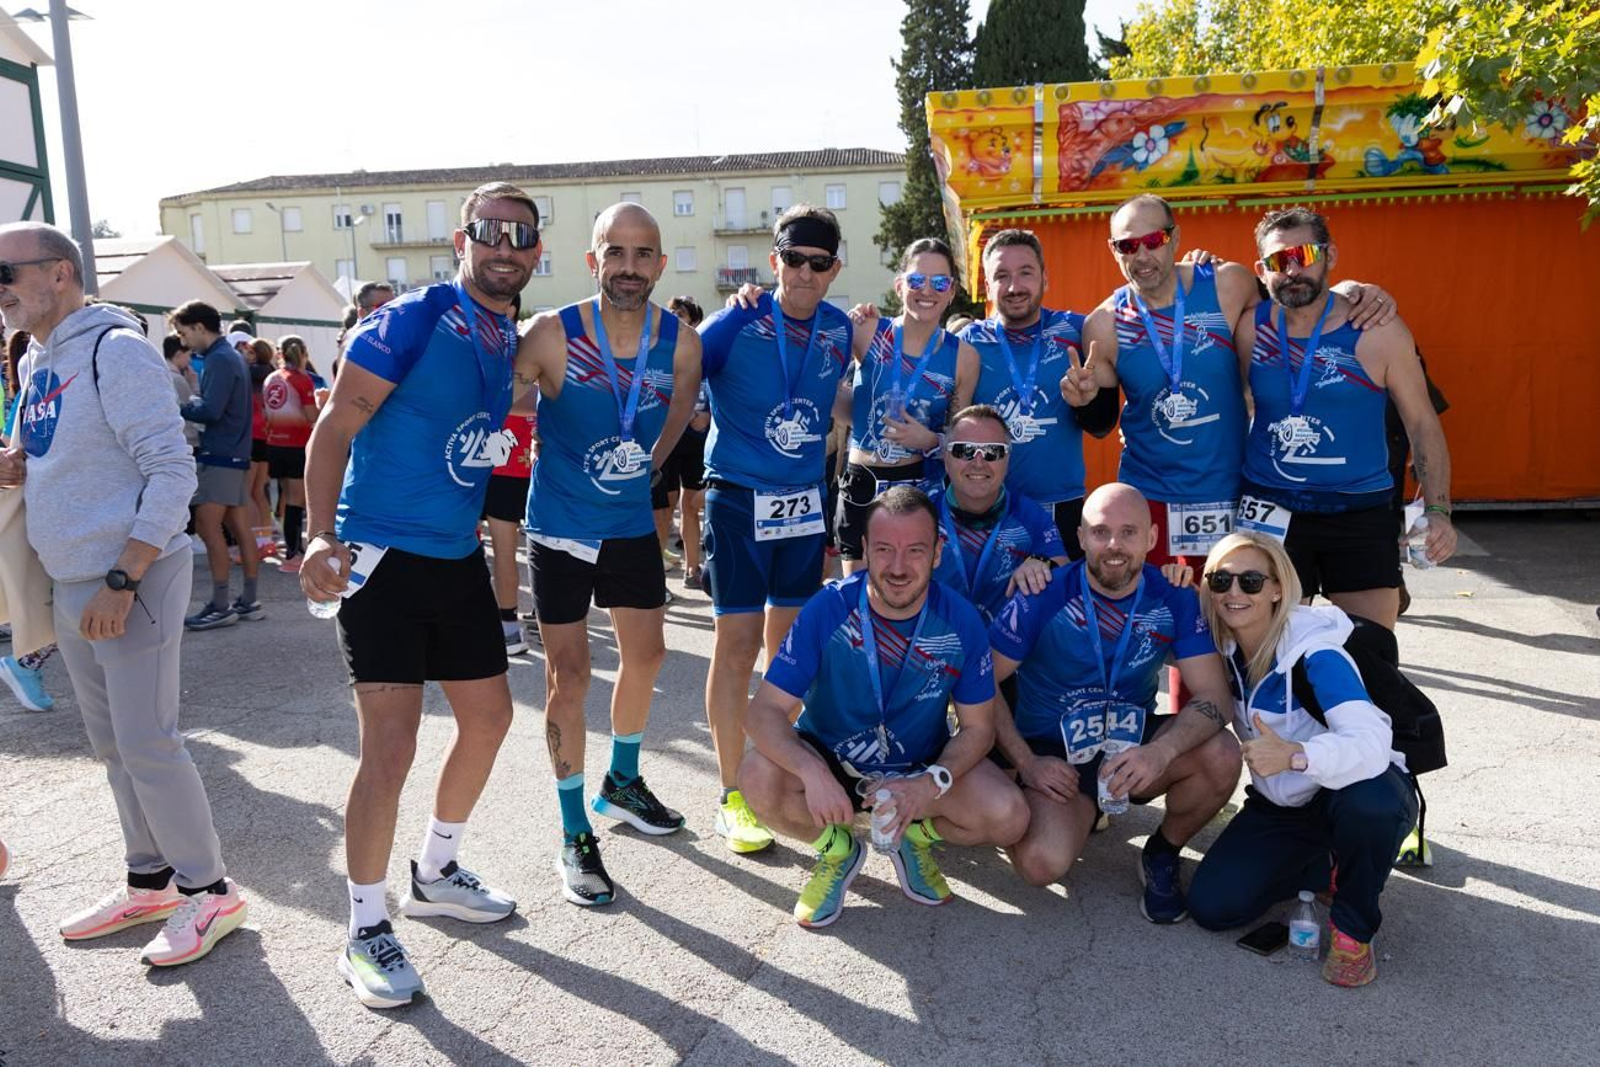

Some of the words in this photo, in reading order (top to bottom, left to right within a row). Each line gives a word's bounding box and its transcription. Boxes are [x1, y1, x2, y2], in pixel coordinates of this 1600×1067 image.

[445, 433, 459, 460] ACTIVA
[456, 414, 476, 432] SPORT
[588, 438, 610, 454] SPORT
[770, 496, 811, 519] 273
[1184, 513, 1230, 534] 651
